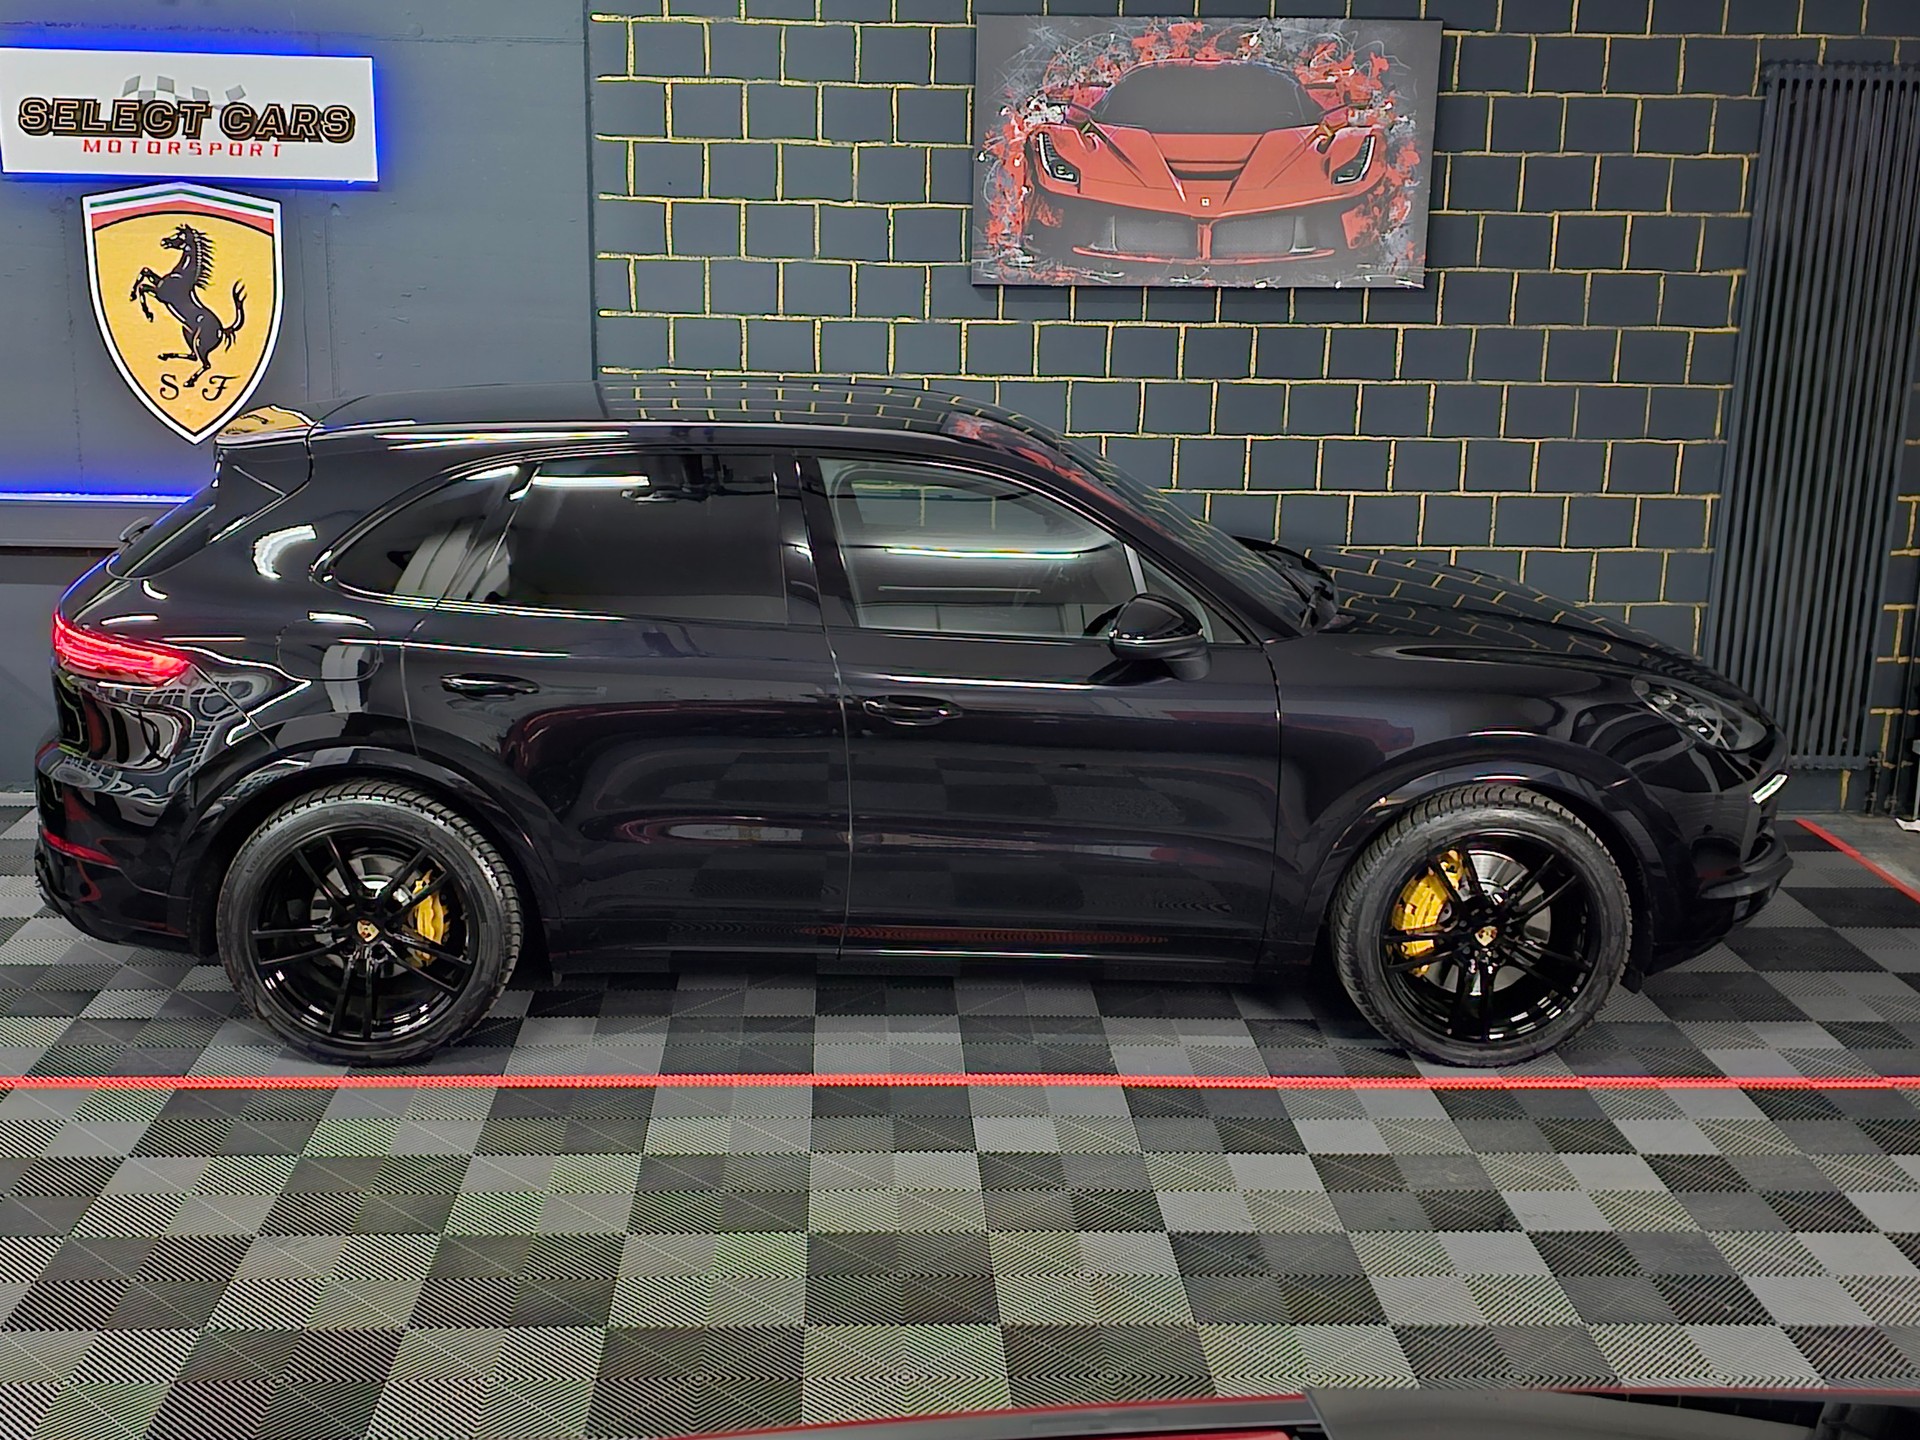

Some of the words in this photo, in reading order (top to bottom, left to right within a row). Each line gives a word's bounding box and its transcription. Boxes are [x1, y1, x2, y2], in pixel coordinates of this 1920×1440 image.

[18, 97, 211, 139] SELECT
[219, 101, 356, 143] CARS
[82, 139, 282, 157] MOTORSPORT
[159, 373, 179, 400] S
[202, 374, 240, 401] F
